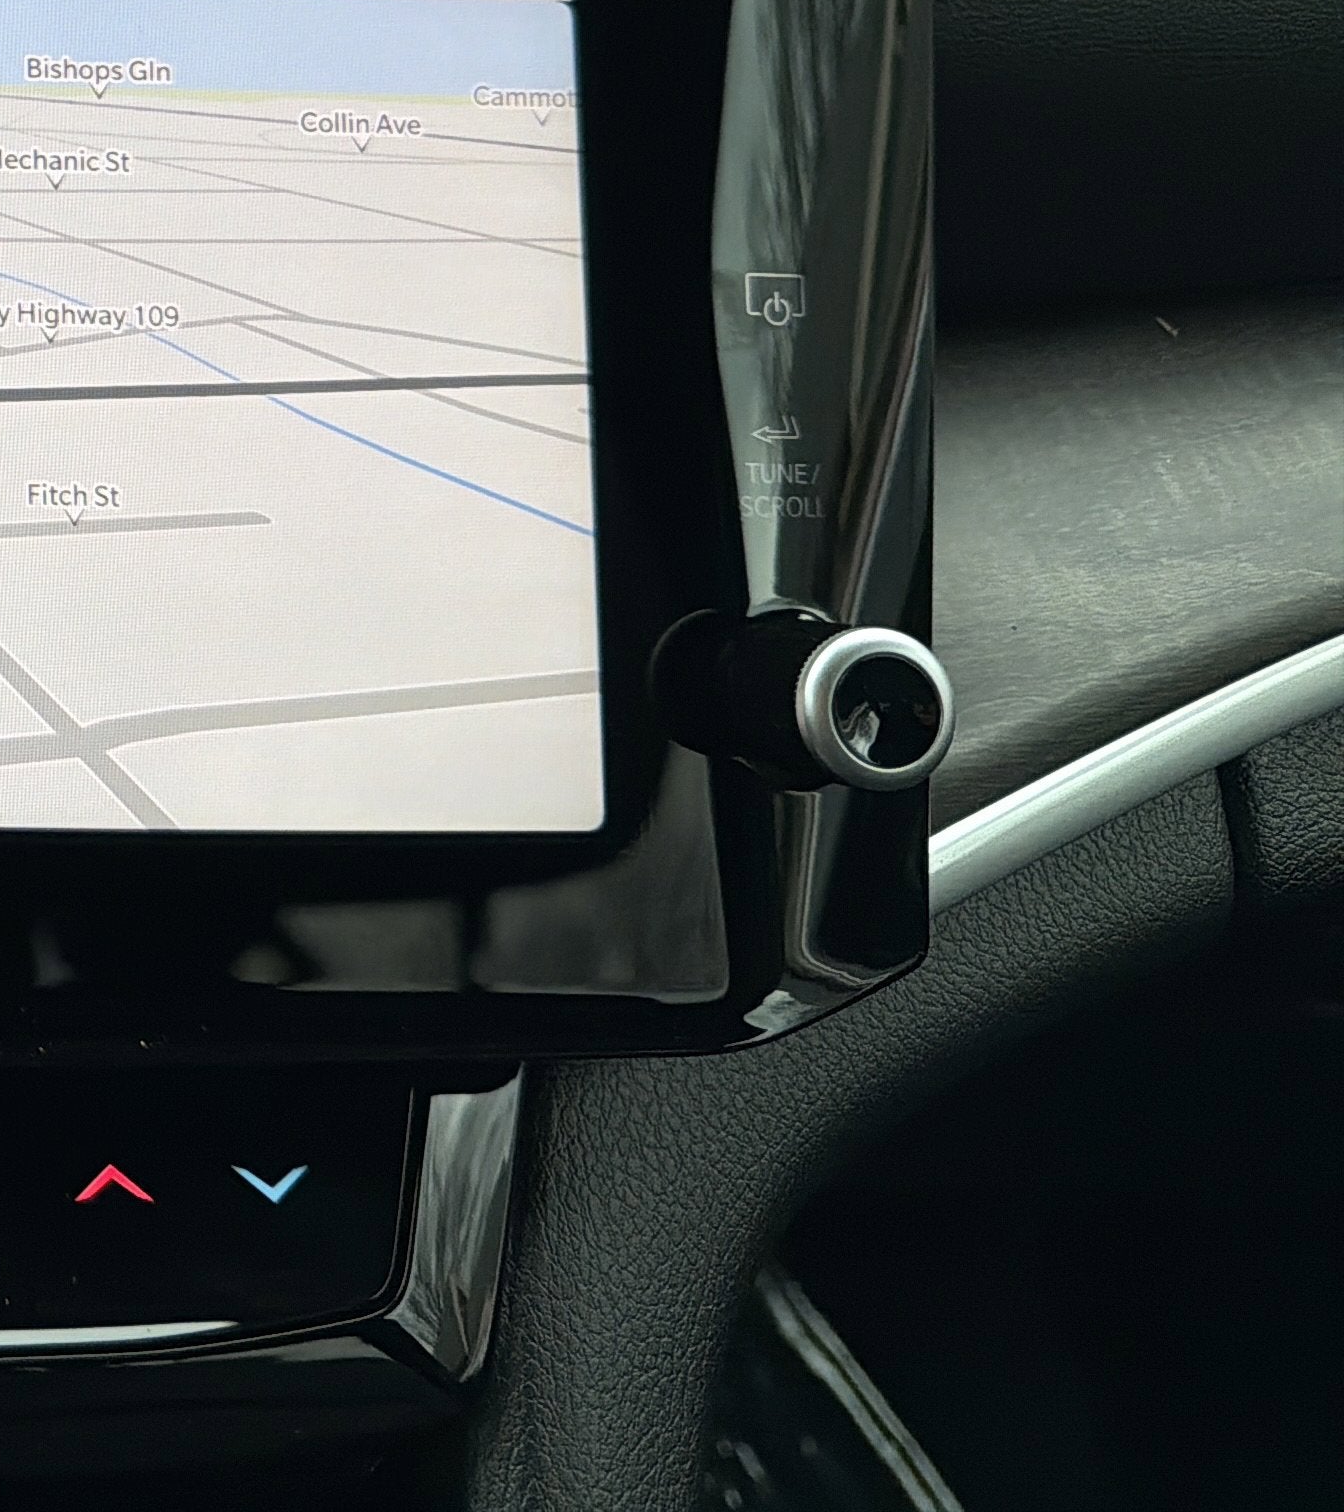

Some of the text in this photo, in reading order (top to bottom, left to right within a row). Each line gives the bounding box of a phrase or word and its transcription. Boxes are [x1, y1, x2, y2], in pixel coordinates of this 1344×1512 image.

[26, 58, 172, 85] Bishops Gln
[300, 112, 421, 136] Collin Ave
[104, 150, 130, 173] St
[18, 303, 125, 333] Highway
[134, 305, 179, 328] 109
[28, 483, 120, 507] Fitch St
[740, 495, 826, 518] SCROLL
